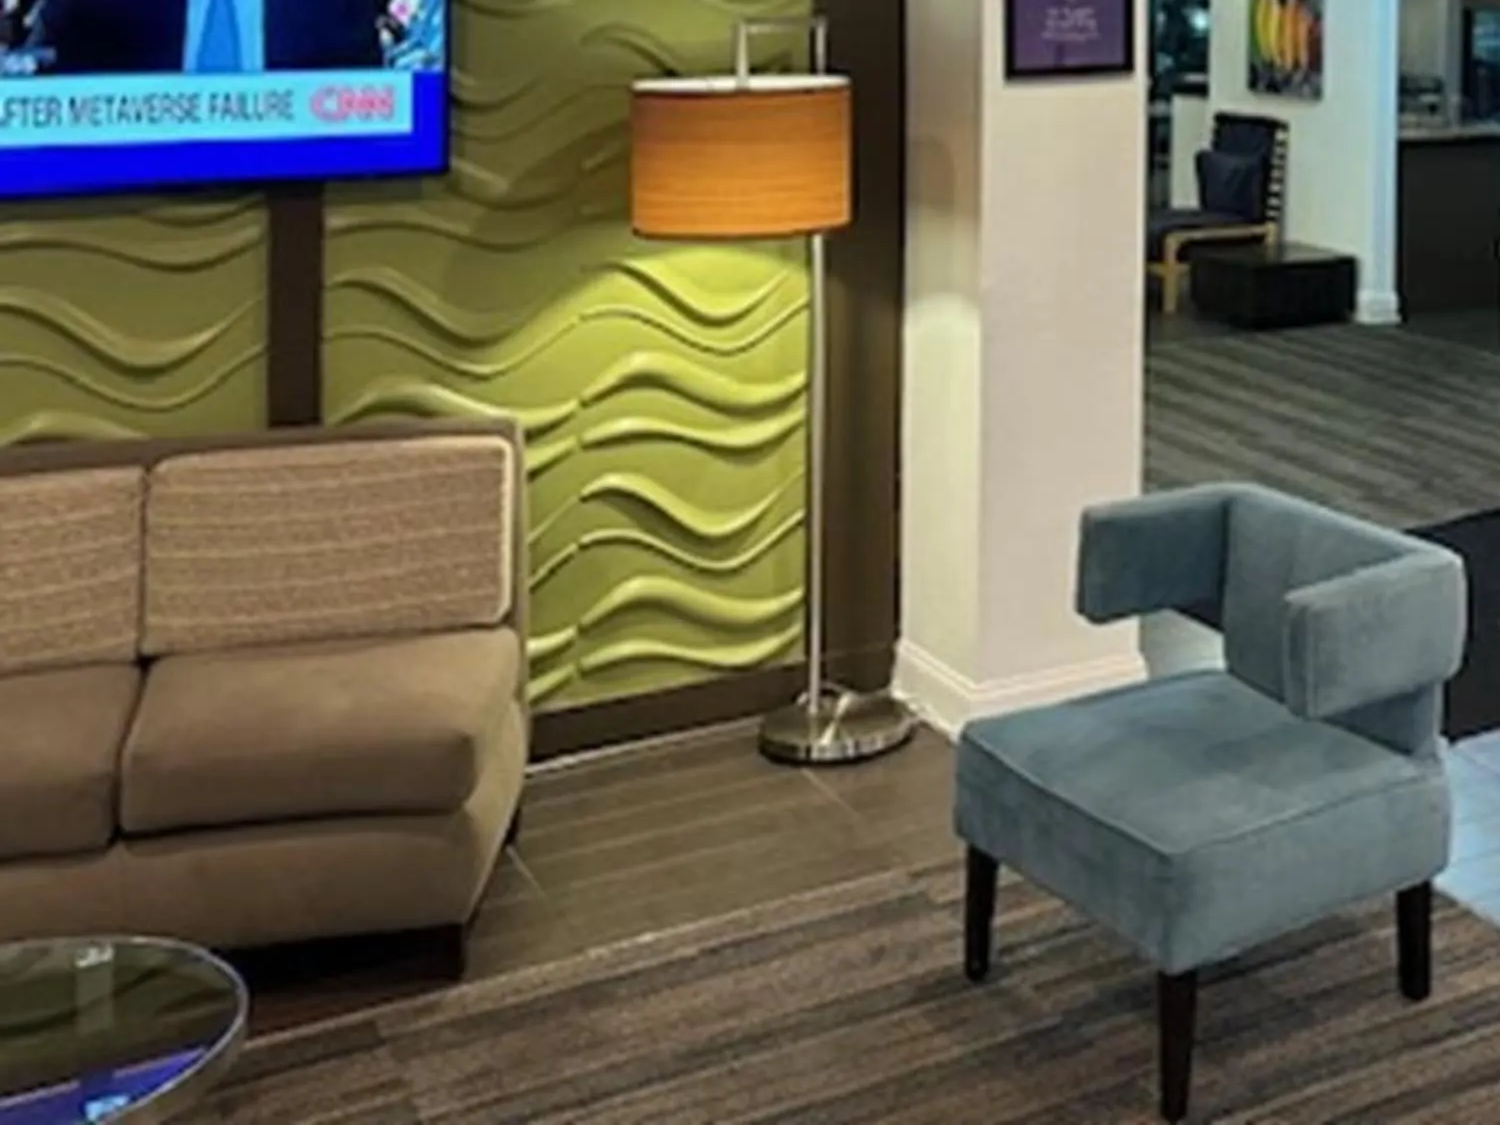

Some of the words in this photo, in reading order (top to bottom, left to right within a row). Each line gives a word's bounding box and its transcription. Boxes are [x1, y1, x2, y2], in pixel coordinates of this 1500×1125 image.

[0, 96, 62, 128] FTER
[68, 93, 201, 127] METAVERSE
[208, 88, 294, 122] FAILURE
[309, 83, 394, 123] CNN
